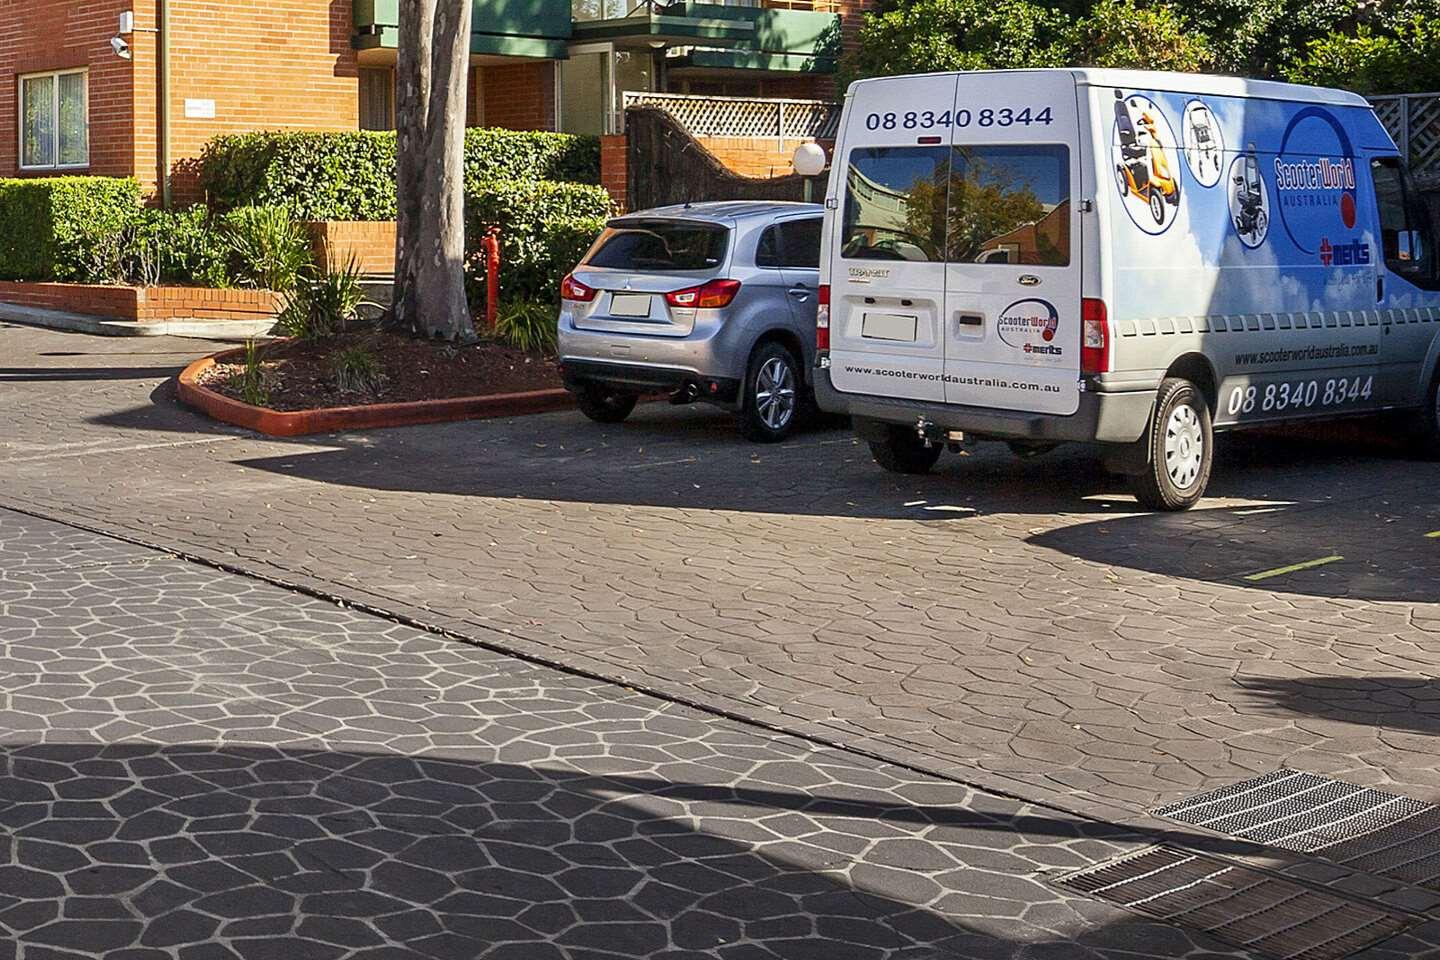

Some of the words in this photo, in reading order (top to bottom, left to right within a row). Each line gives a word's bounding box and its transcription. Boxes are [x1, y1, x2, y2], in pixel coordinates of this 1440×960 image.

[866, 113, 897, 130] 08
[902, 110, 971, 129] 8340
[978, 107, 1054, 127] 8344
[1274, 158, 1356, 189] ScooterWorld
[1283, 193, 1338, 207] AUSTRALIA
[998, 315, 1057, 329] ScooterWorld
[1235, 343, 1378, 365] www.scooterworldaustralia.com.au
[845, 365, 1060, 393] www.scooterworldaustralia.com.au
[1228, 386, 1257, 415] 08
[1262, 380, 1318, 411] 8340
[1322, 376, 1373, 405] 8344
